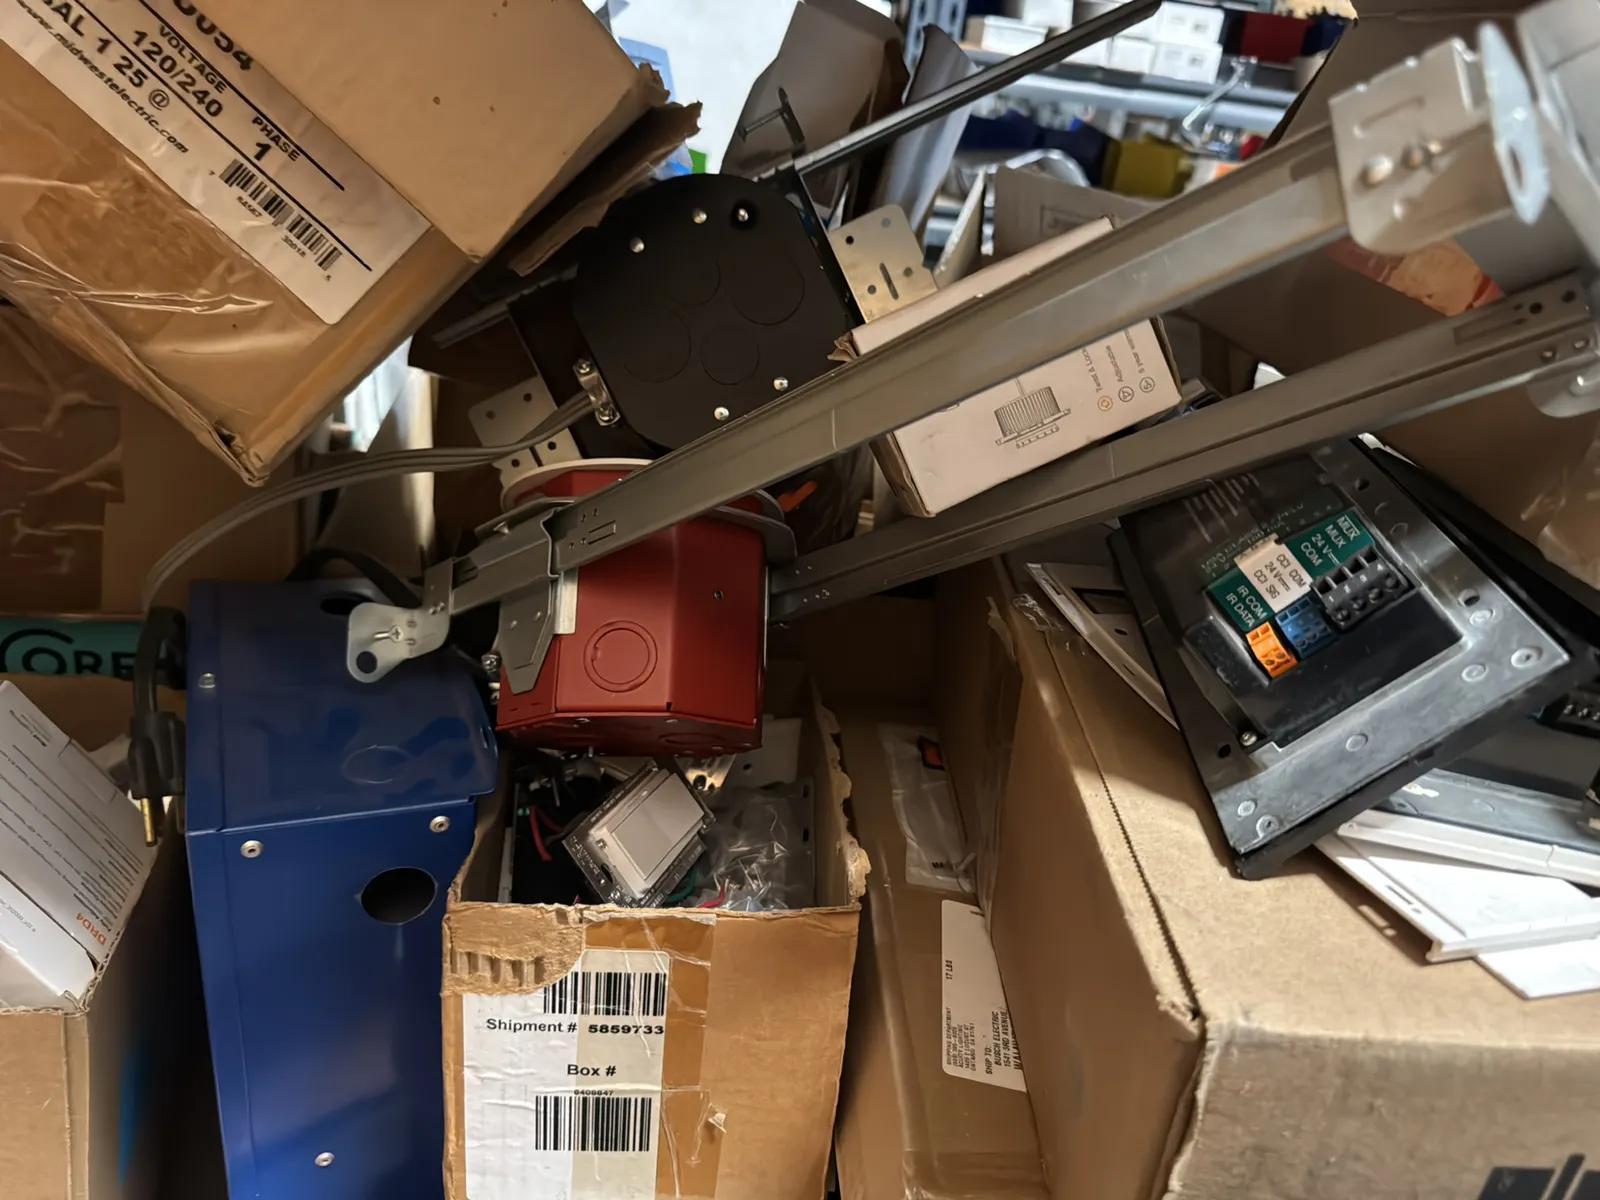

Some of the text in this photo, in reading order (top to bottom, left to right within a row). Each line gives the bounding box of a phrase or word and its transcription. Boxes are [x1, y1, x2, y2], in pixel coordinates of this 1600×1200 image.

[96, 37, 112, 54] 1
[113, 55, 149, 88] 25
[159, 24, 228, 94] VOLTAGE
[132, 30, 223, 117] 120/240
[251, 116, 301, 162] PHASE
[254, 141, 273, 162] 1
[1325, 524, 1347, 549] MUX
[1336, 515, 1360, 541] MUX
[1300, 542, 1323, 567] COM
[1264, 562, 1277, 577] 24
[1288, 569, 1307, 588] COM
[1226, 593, 1255, 627] IR DATA
[1237, 585, 1268, 620] IR COM
[76, 911, 107, 945] DRD4
[486, 1018, 665, 1035] Shipment # 5859733
[992, 1011, 1002, 1066] BUSCH ELECTRIC
[566, 1064, 617, 1077] Box #
[985, 1058, 993, 1075] SHIP
